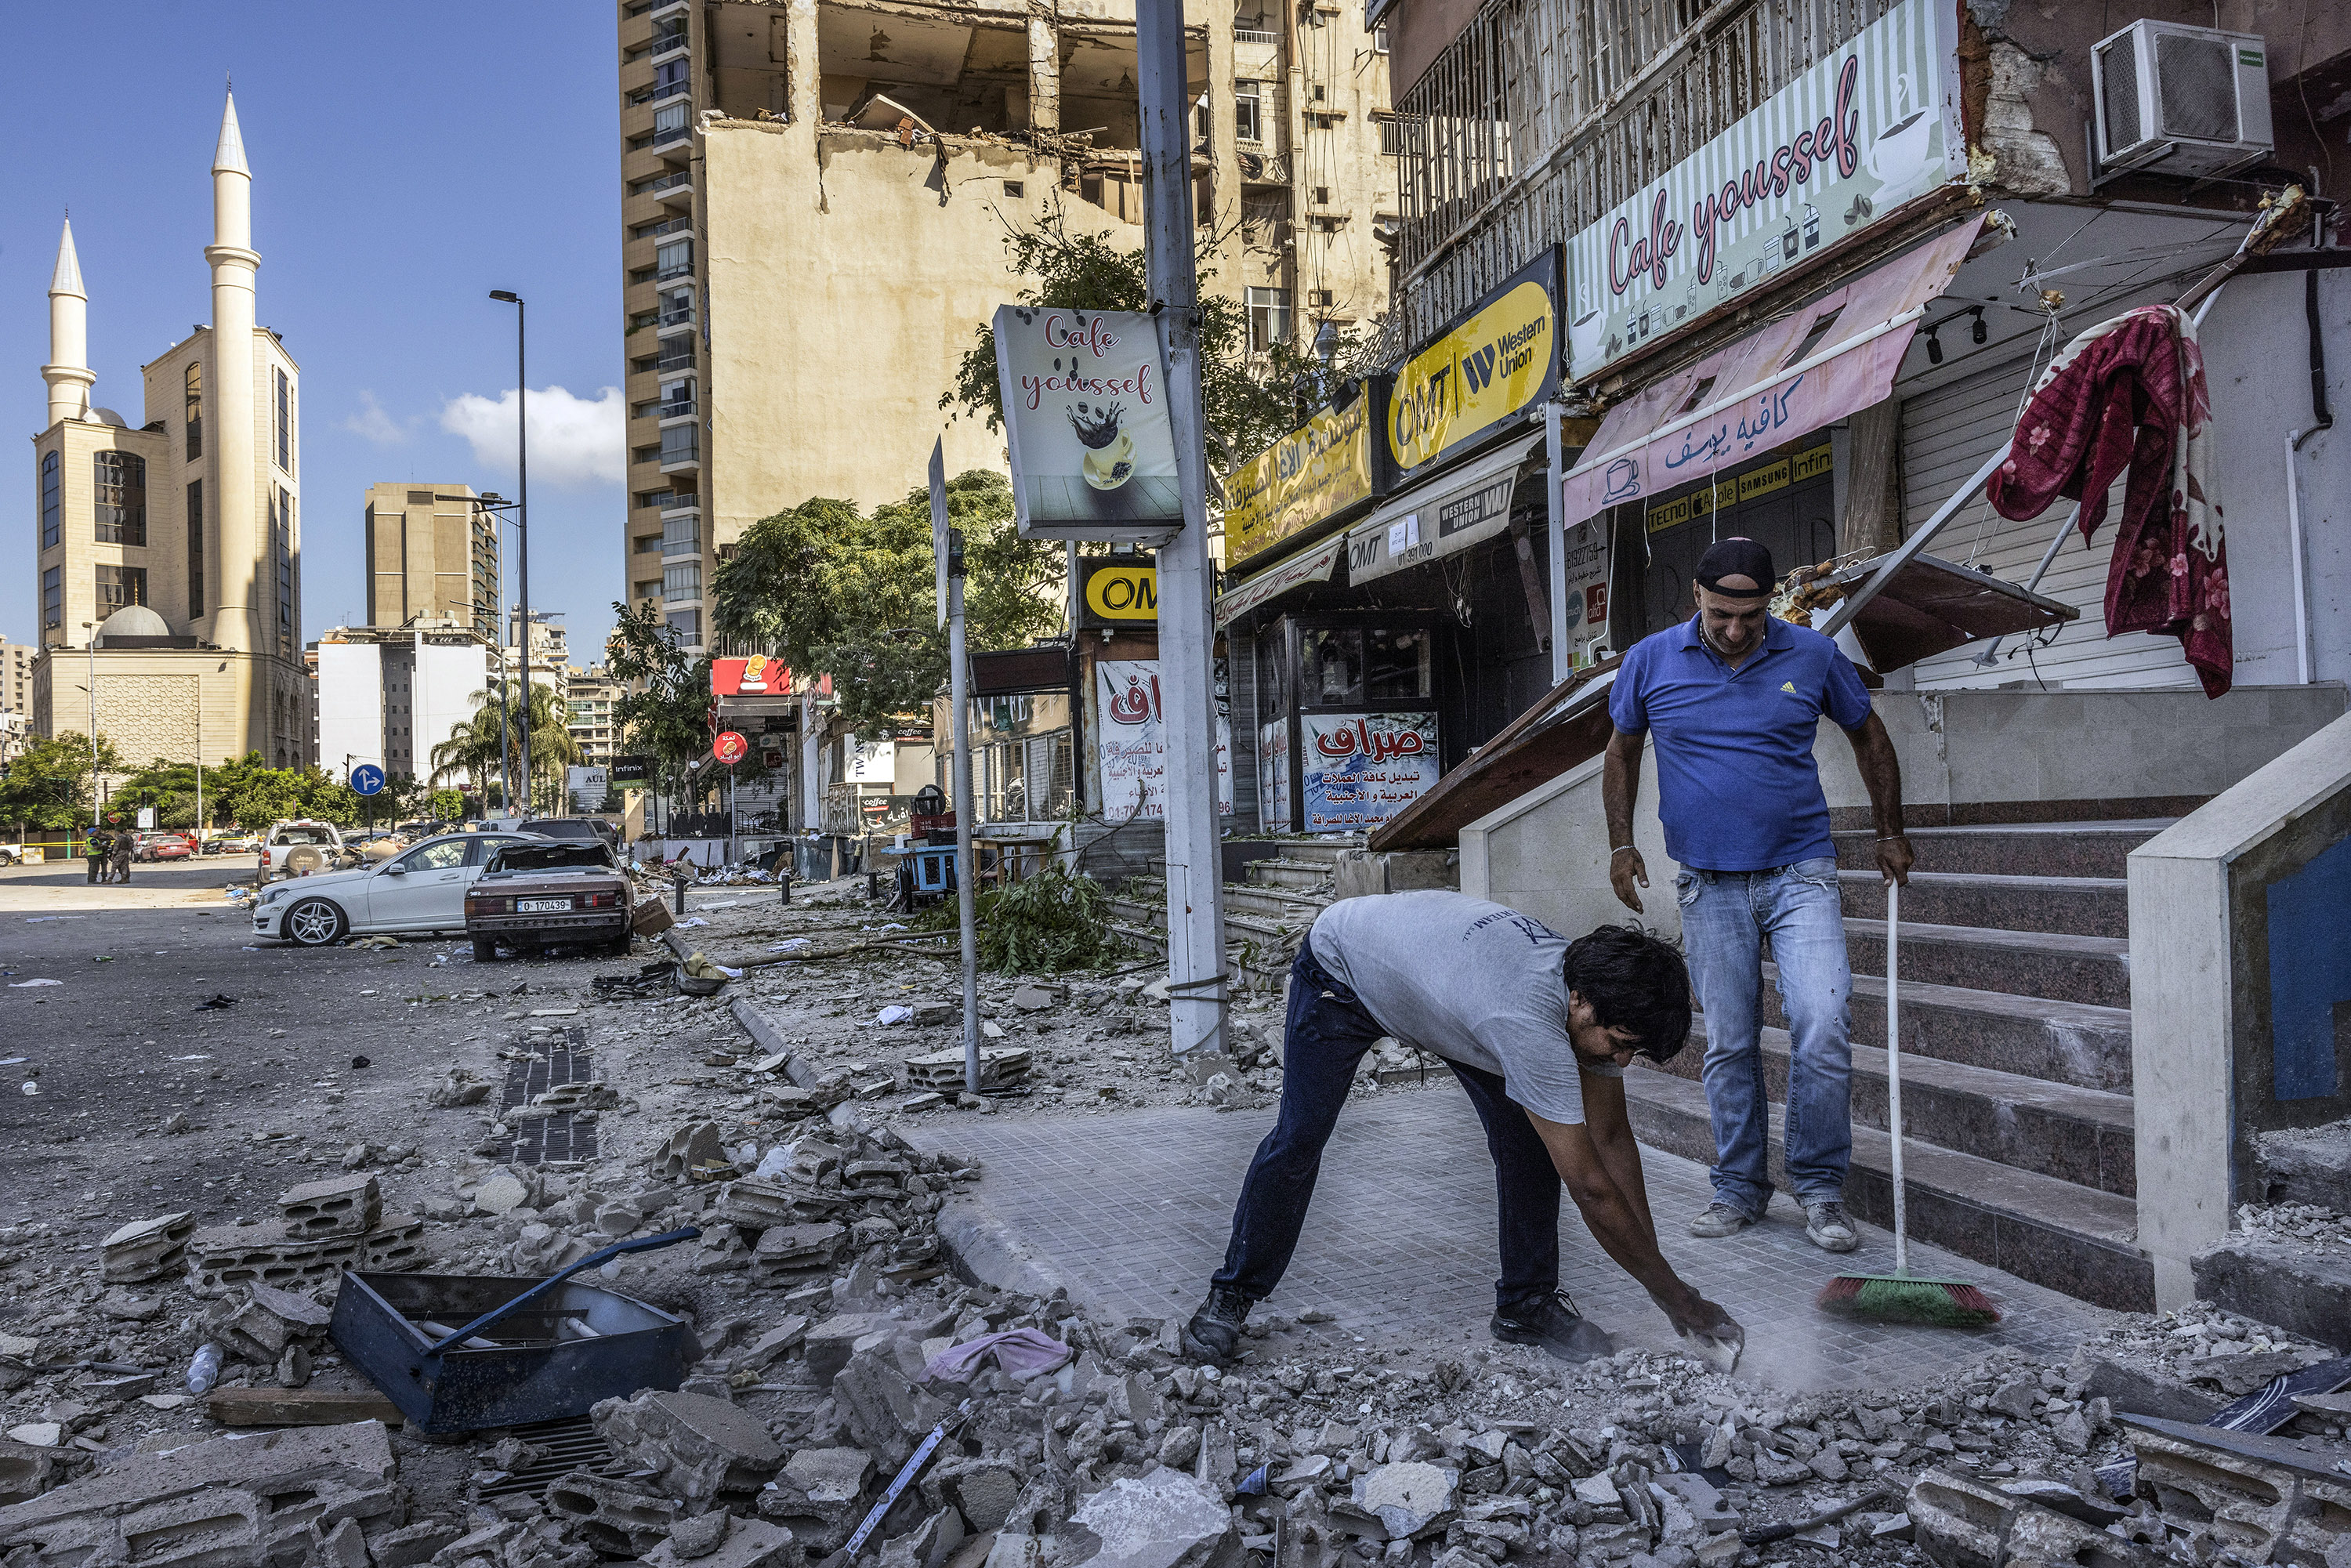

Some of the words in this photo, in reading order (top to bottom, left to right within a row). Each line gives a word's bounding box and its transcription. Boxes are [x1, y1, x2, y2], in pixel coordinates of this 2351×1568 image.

[1610, 188, 1683, 295] Cafe
[1694, 54, 1858, 285] youssef
[1045, 314, 1121, 357] Cafe
[1498, 315, 1545, 357] Western
[1498, 347, 1532, 379] Union
[1021, 364, 1153, 411] youssef
[1396, 364, 1451, 446] OMT
[1737, 374, 1804, 451] كافيه
[1665, 424, 1731, 469] يوسف
[1741, 468, 1788, 494] SAMSUNG
[1441, 498, 1480, 521] WESTERN
[1484, 482, 1510, 517] WU
[1704, 487, 1733, 509] Apple
[1452, 512, 1480, 530] UNION
[1649, 502, 1686, 529] TECNO
[1349, 536, 1382, 572] OMT
[1102, 578, 1158, 610] OM
[1588, 603, 1601, 619] alfa
[897, 728, 922, 737] coffee
[1317, 718, 1425, 763] صراف
[616, 764, 643, 773] Infinix
[1322, 772, 1360, 784] العملات
[1364, 771, 1386, 782] كافة
[1389, 770, 1420, 785] تبديل
[864, 797, 887, 807] coffee
[1381, 790, 1418, 803] العربية
[1144, 803, 1163, 817] 174
[1313, 813, 1342, 828] للصرافة
[1364, 813, 1383, 824] محمد
[535, 900, 565, 911] 170439
